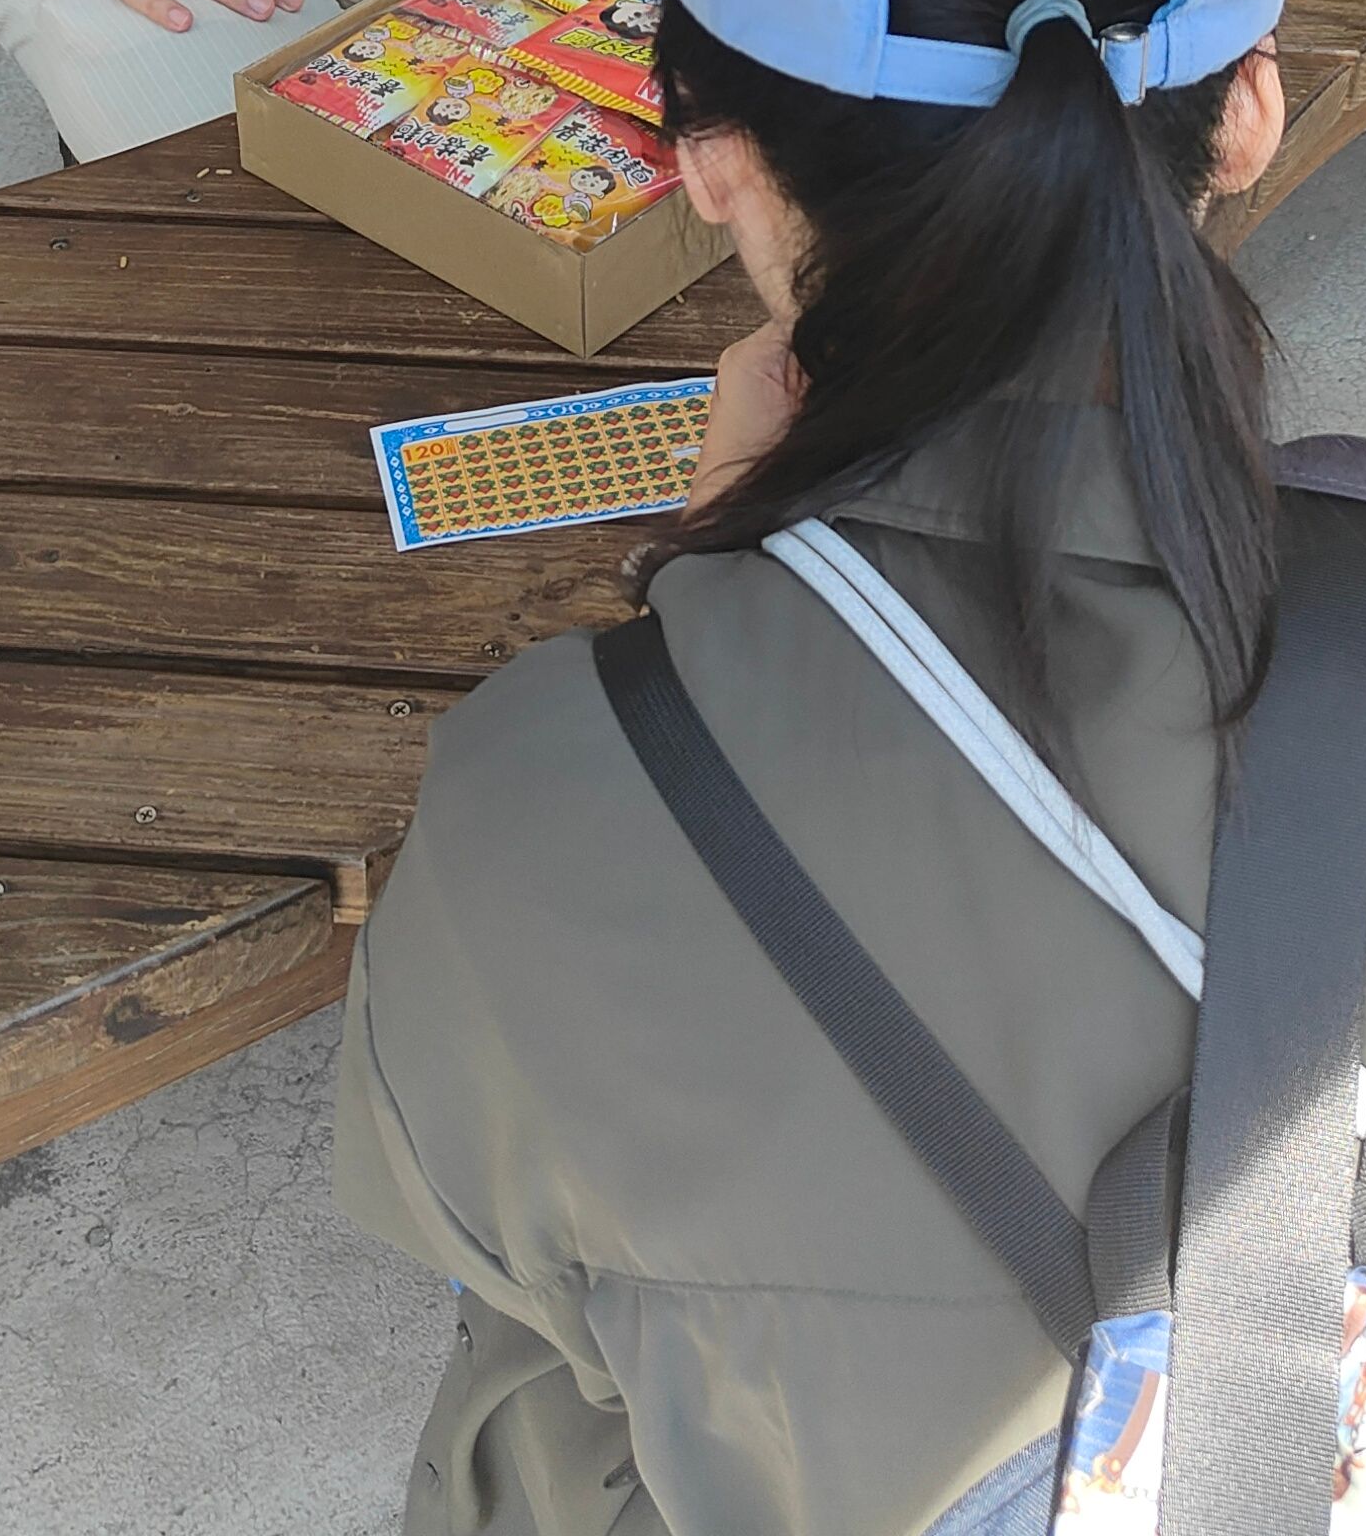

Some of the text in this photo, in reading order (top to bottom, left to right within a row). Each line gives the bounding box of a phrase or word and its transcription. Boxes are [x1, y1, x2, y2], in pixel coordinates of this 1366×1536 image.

[393, 117, 495, 168] 香菇肉麵
[555, 120, 656, 189] 香菇肉麵
[402, 442, 445, 462] 120
